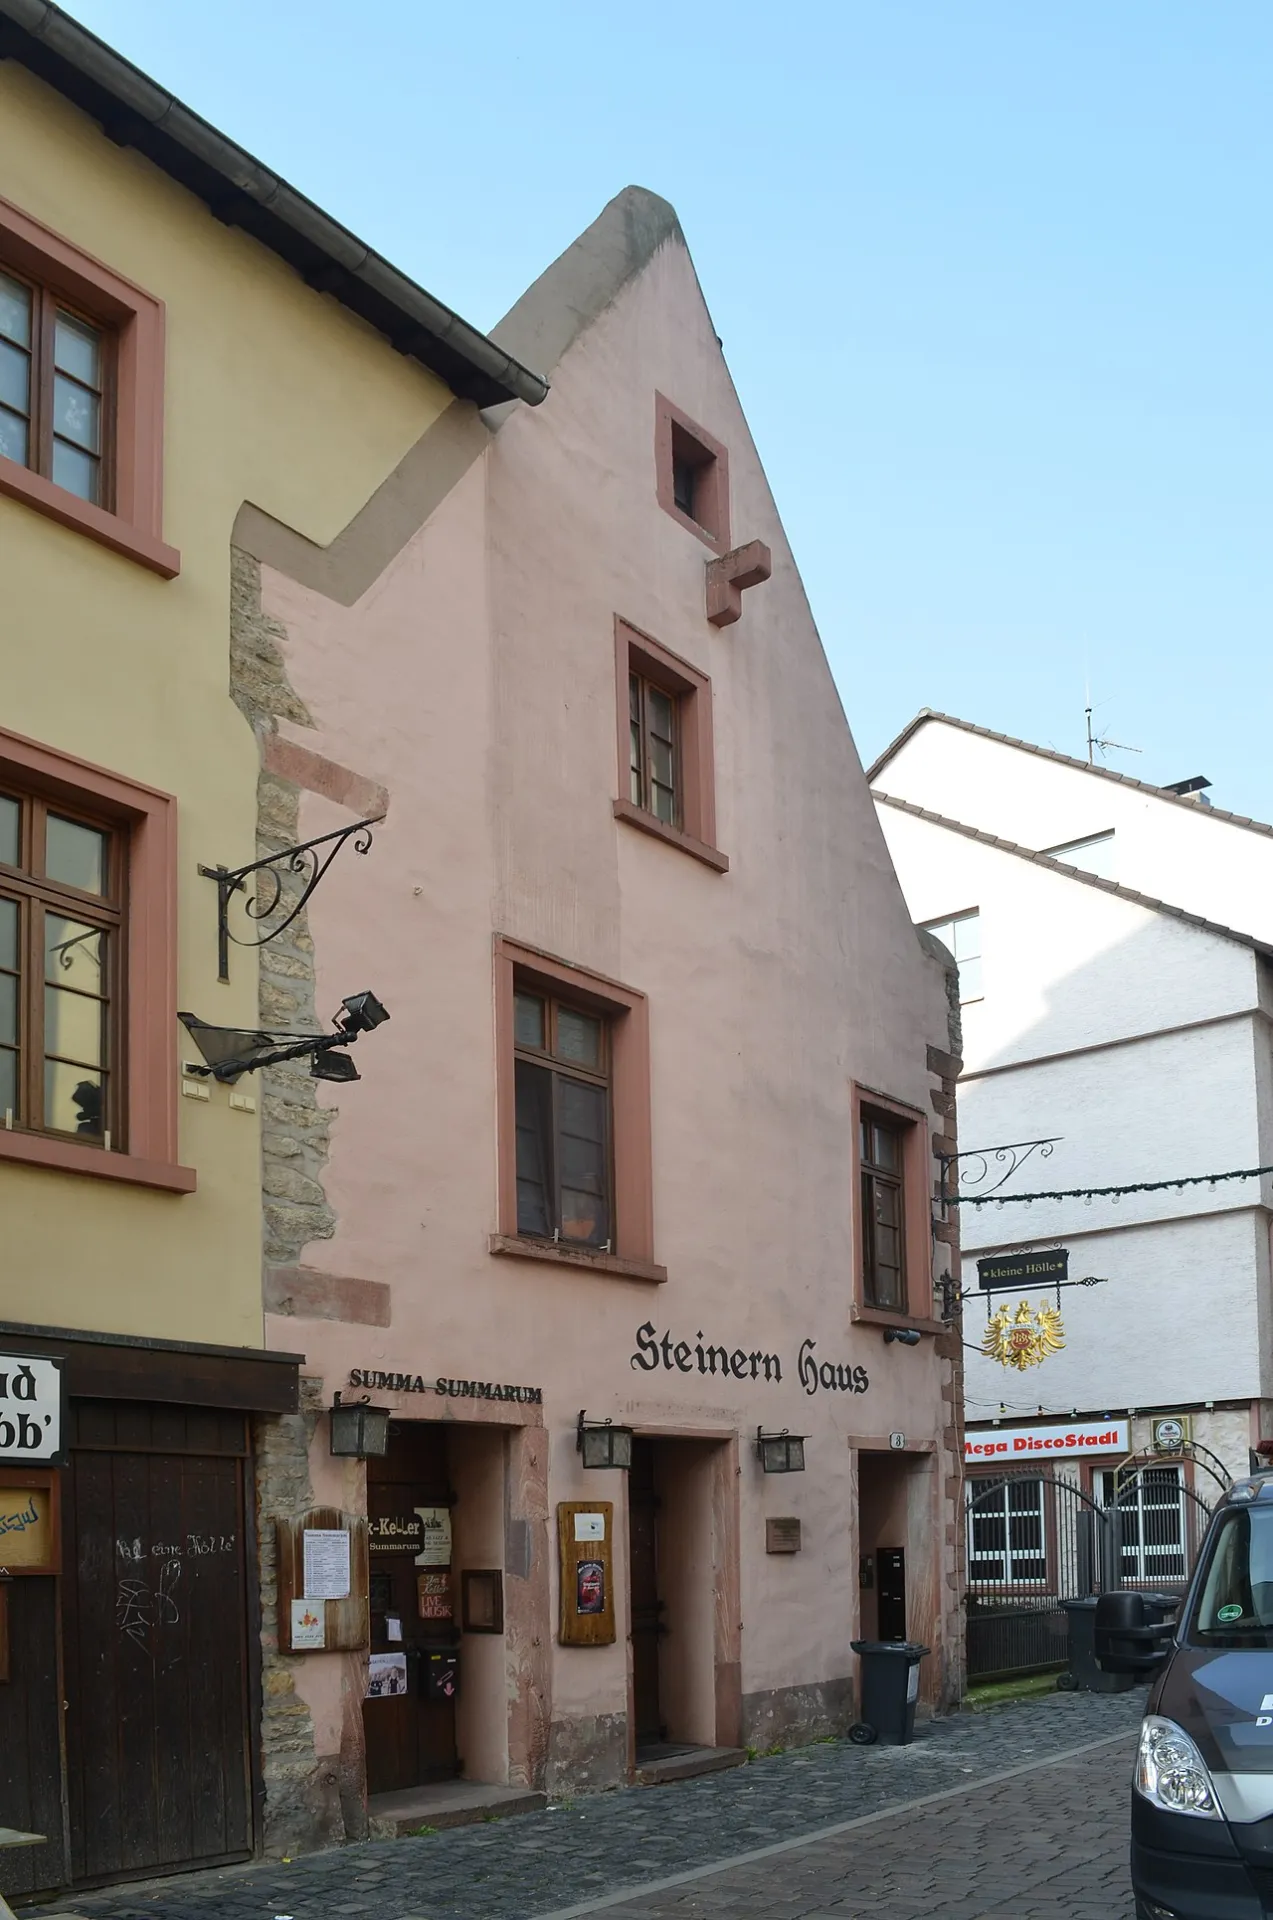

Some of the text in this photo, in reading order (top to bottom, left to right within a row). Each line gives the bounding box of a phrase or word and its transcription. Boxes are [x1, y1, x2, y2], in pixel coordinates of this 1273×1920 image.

[990, 1262, 1056, 1278] kleine Hölle
[630, 1321, 869, 1396] Steinern Haus
[349, 1368, 543, 1404] SUMMA SUMMARUM
[1013, 1430, 1118, 1451] DiscoStadl
[369, 1542, 420, 1551] Summarum
[421, 1595, 441, 1606] LIVE
[422, 1605, 452, 1618] MUSIK
